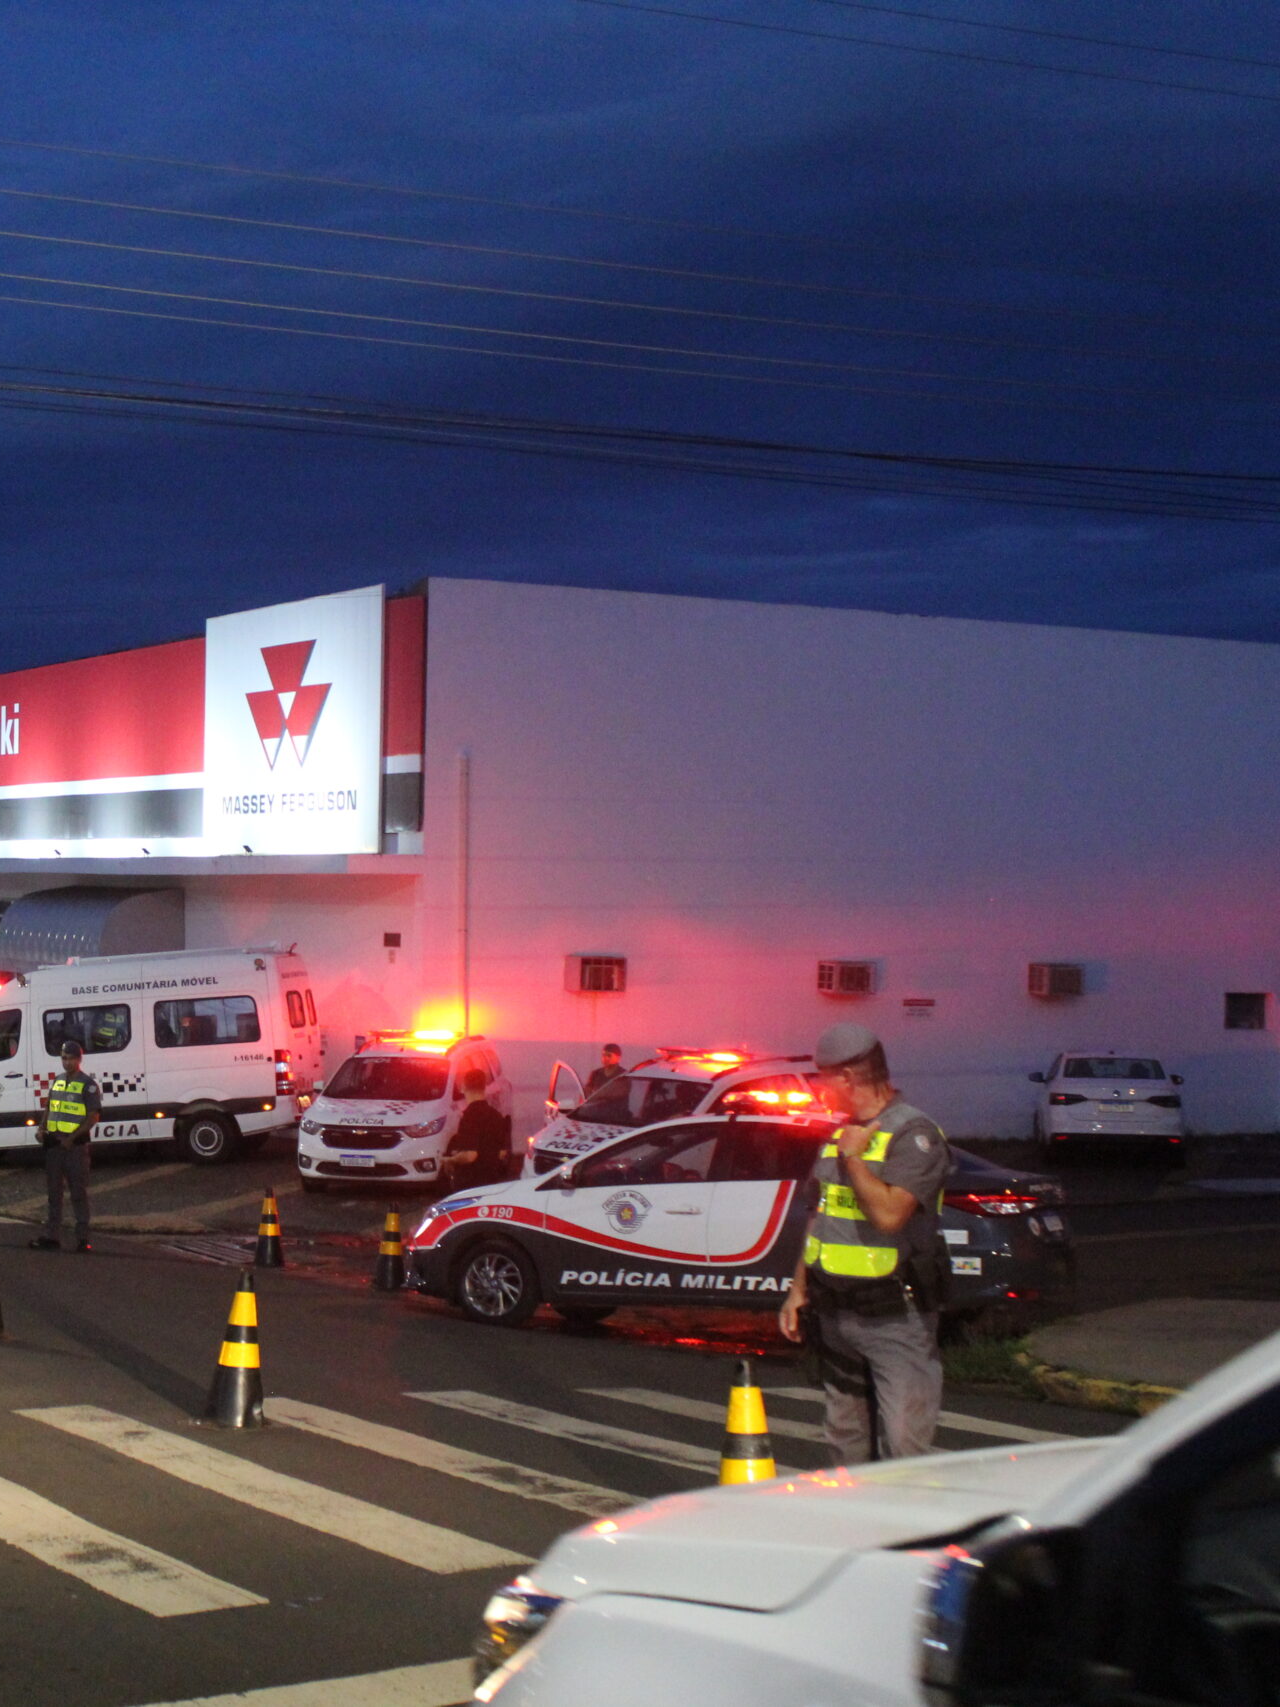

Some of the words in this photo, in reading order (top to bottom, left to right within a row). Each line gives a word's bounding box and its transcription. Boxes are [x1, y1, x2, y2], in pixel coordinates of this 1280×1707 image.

[222, 794, 275, 815] MASSEY
[281, 789, 357, 813] FERGUSON
[72, 986, 99, 995] BASE
[102, 979, 178, 993] COMUNITÁRIA
[181, 976, 219, 987] MÓVEL
[491, 1207, 514, 1218] 190
[560, 1268, 671, 1287] POLÍCIA
